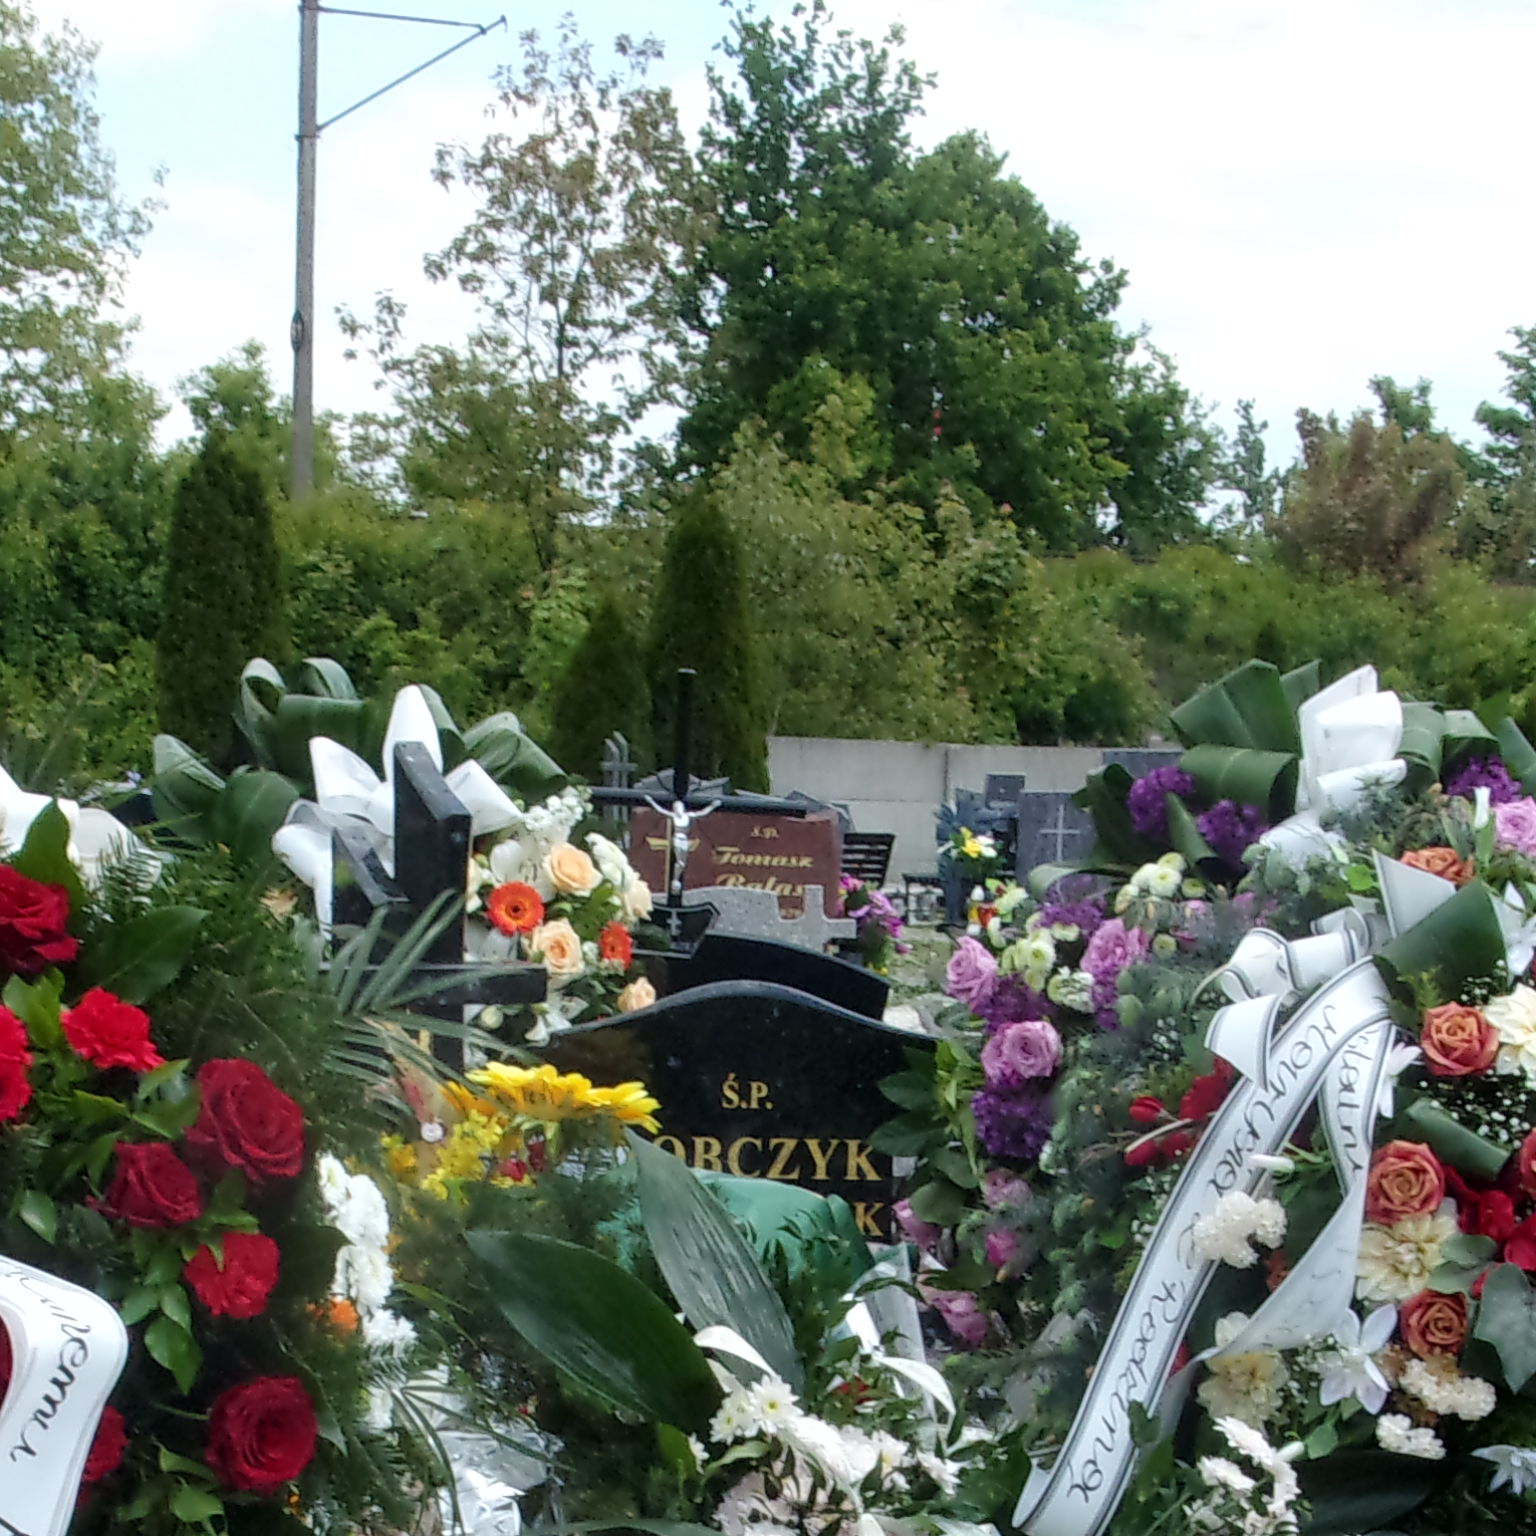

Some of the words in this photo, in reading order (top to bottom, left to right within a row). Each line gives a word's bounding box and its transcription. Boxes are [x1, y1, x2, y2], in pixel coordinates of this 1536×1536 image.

[712, 846, 814, 868] Tomasz
[721, 1072, 774, 1110] Ś.P.
[653, 1135, 883, 1182] OBCZYK
